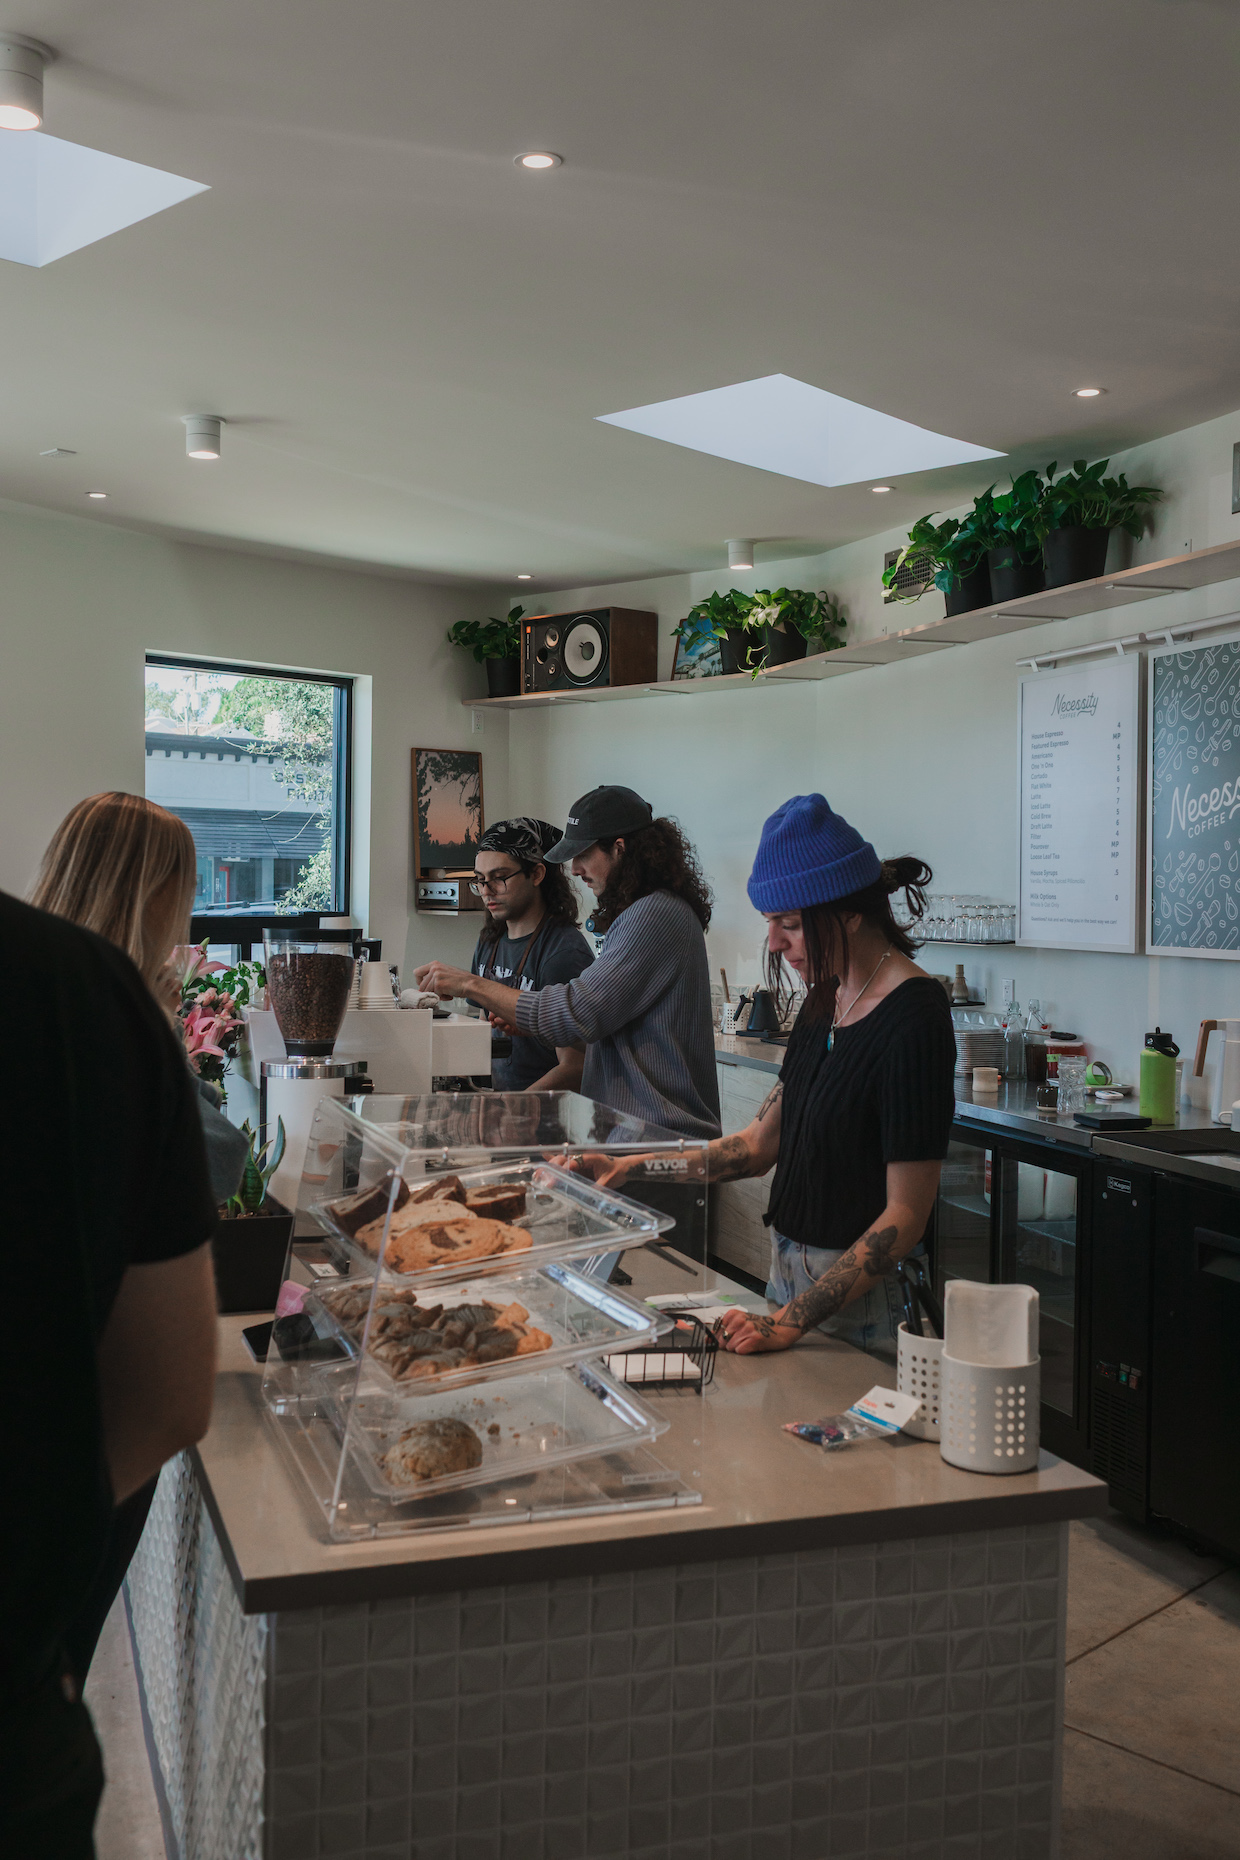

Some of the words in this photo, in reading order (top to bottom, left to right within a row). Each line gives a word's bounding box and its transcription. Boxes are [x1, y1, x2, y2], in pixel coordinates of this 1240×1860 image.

[1050, 692, 1099, 716] Necessity
[1060, 712, 1076, 720] COFFEE
[1045, 730, 1064, 739] Espresso
[1050, 740, 1069, 748] Espresso
[1188, 812, 1226, 838] COFFEE
[644, 1158, 688, 1170] VEVOR
